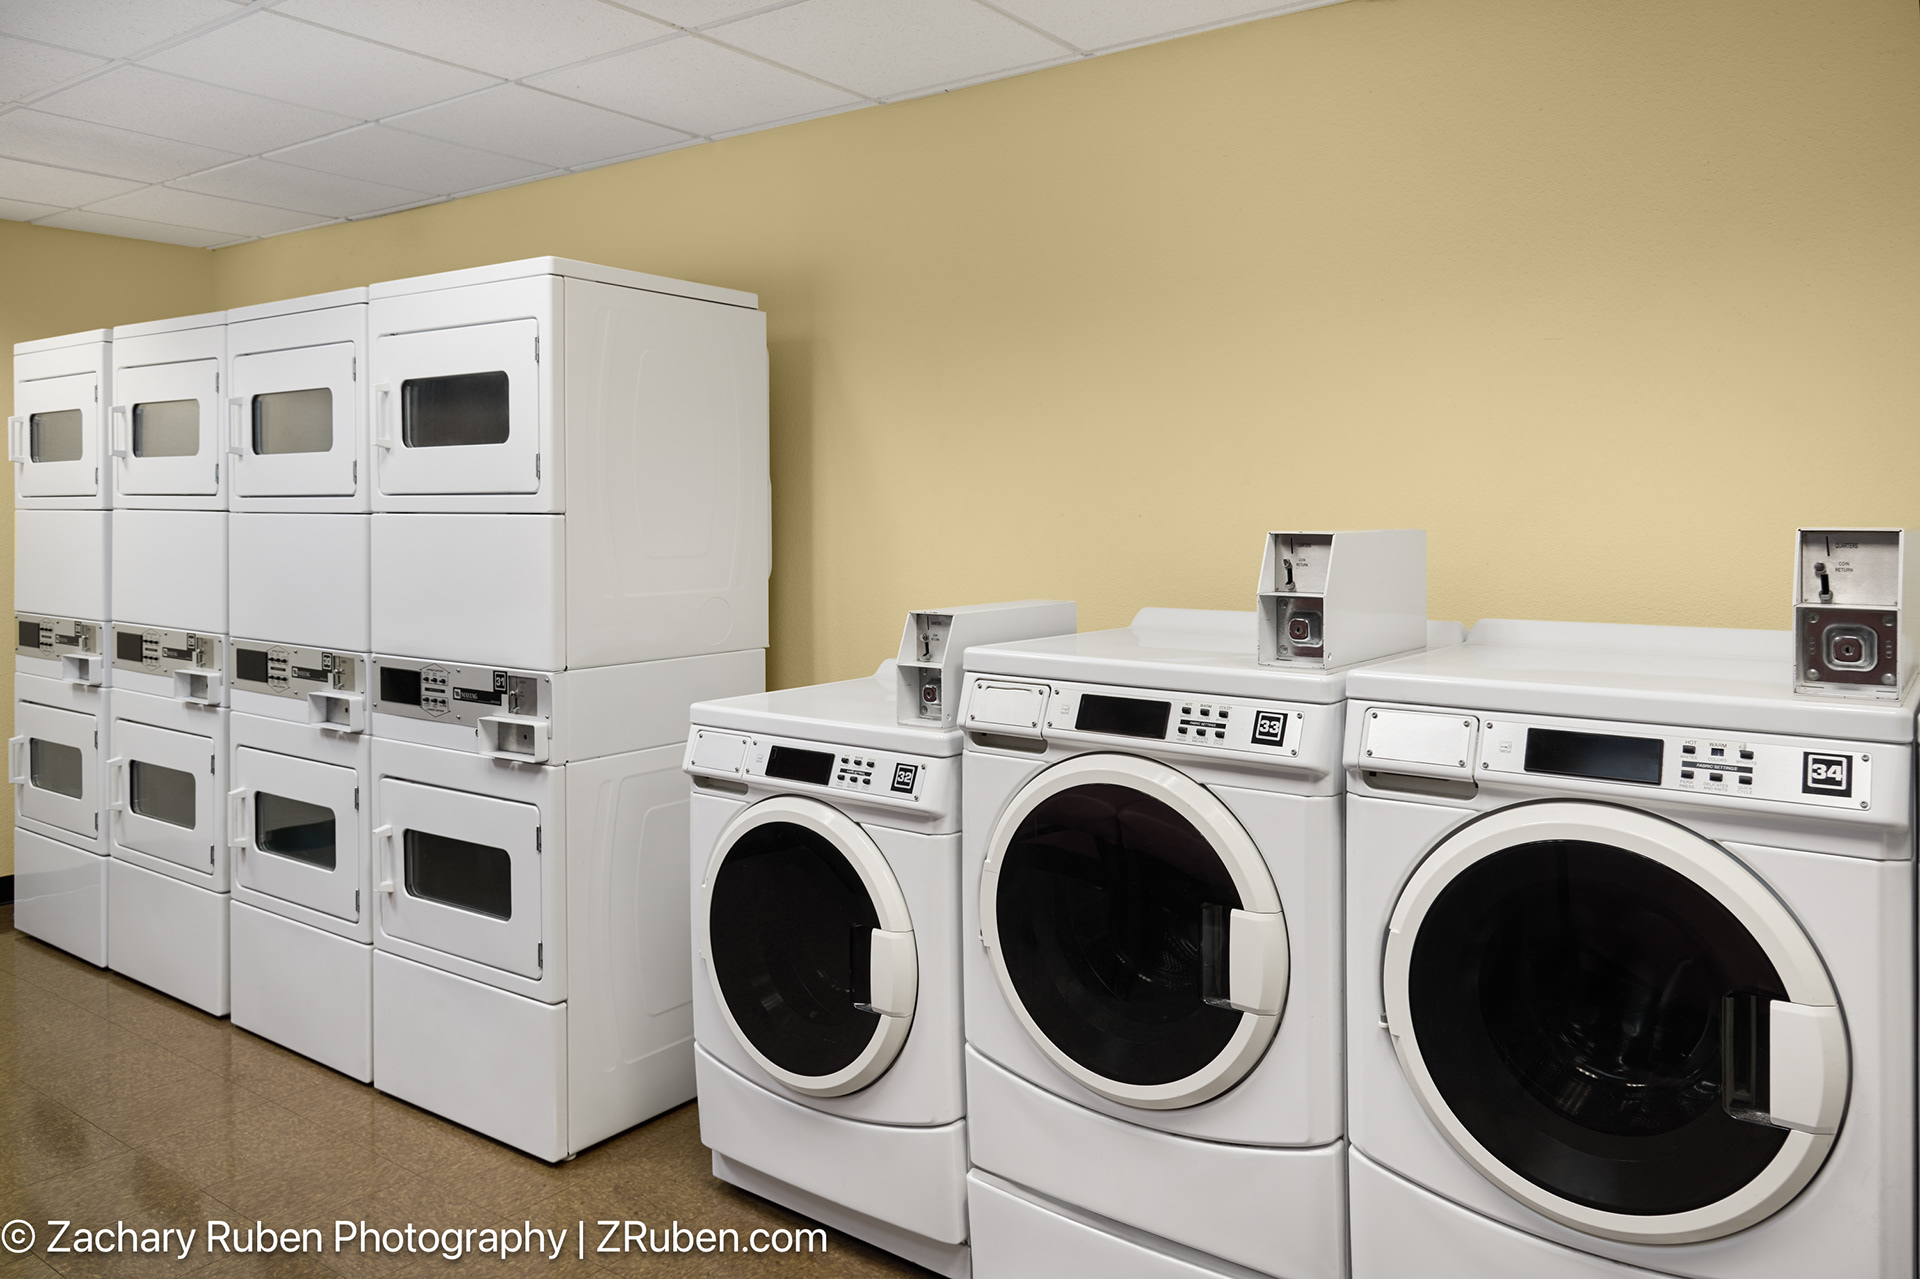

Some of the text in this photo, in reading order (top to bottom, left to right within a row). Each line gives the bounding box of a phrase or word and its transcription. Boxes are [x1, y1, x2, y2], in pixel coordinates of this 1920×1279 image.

[495, 677, 505, 686] 31
[1260, 720, 1280, 734] 33
[898, 771, 912, 783] 32
[1812, 763, 1842, 781] 34
